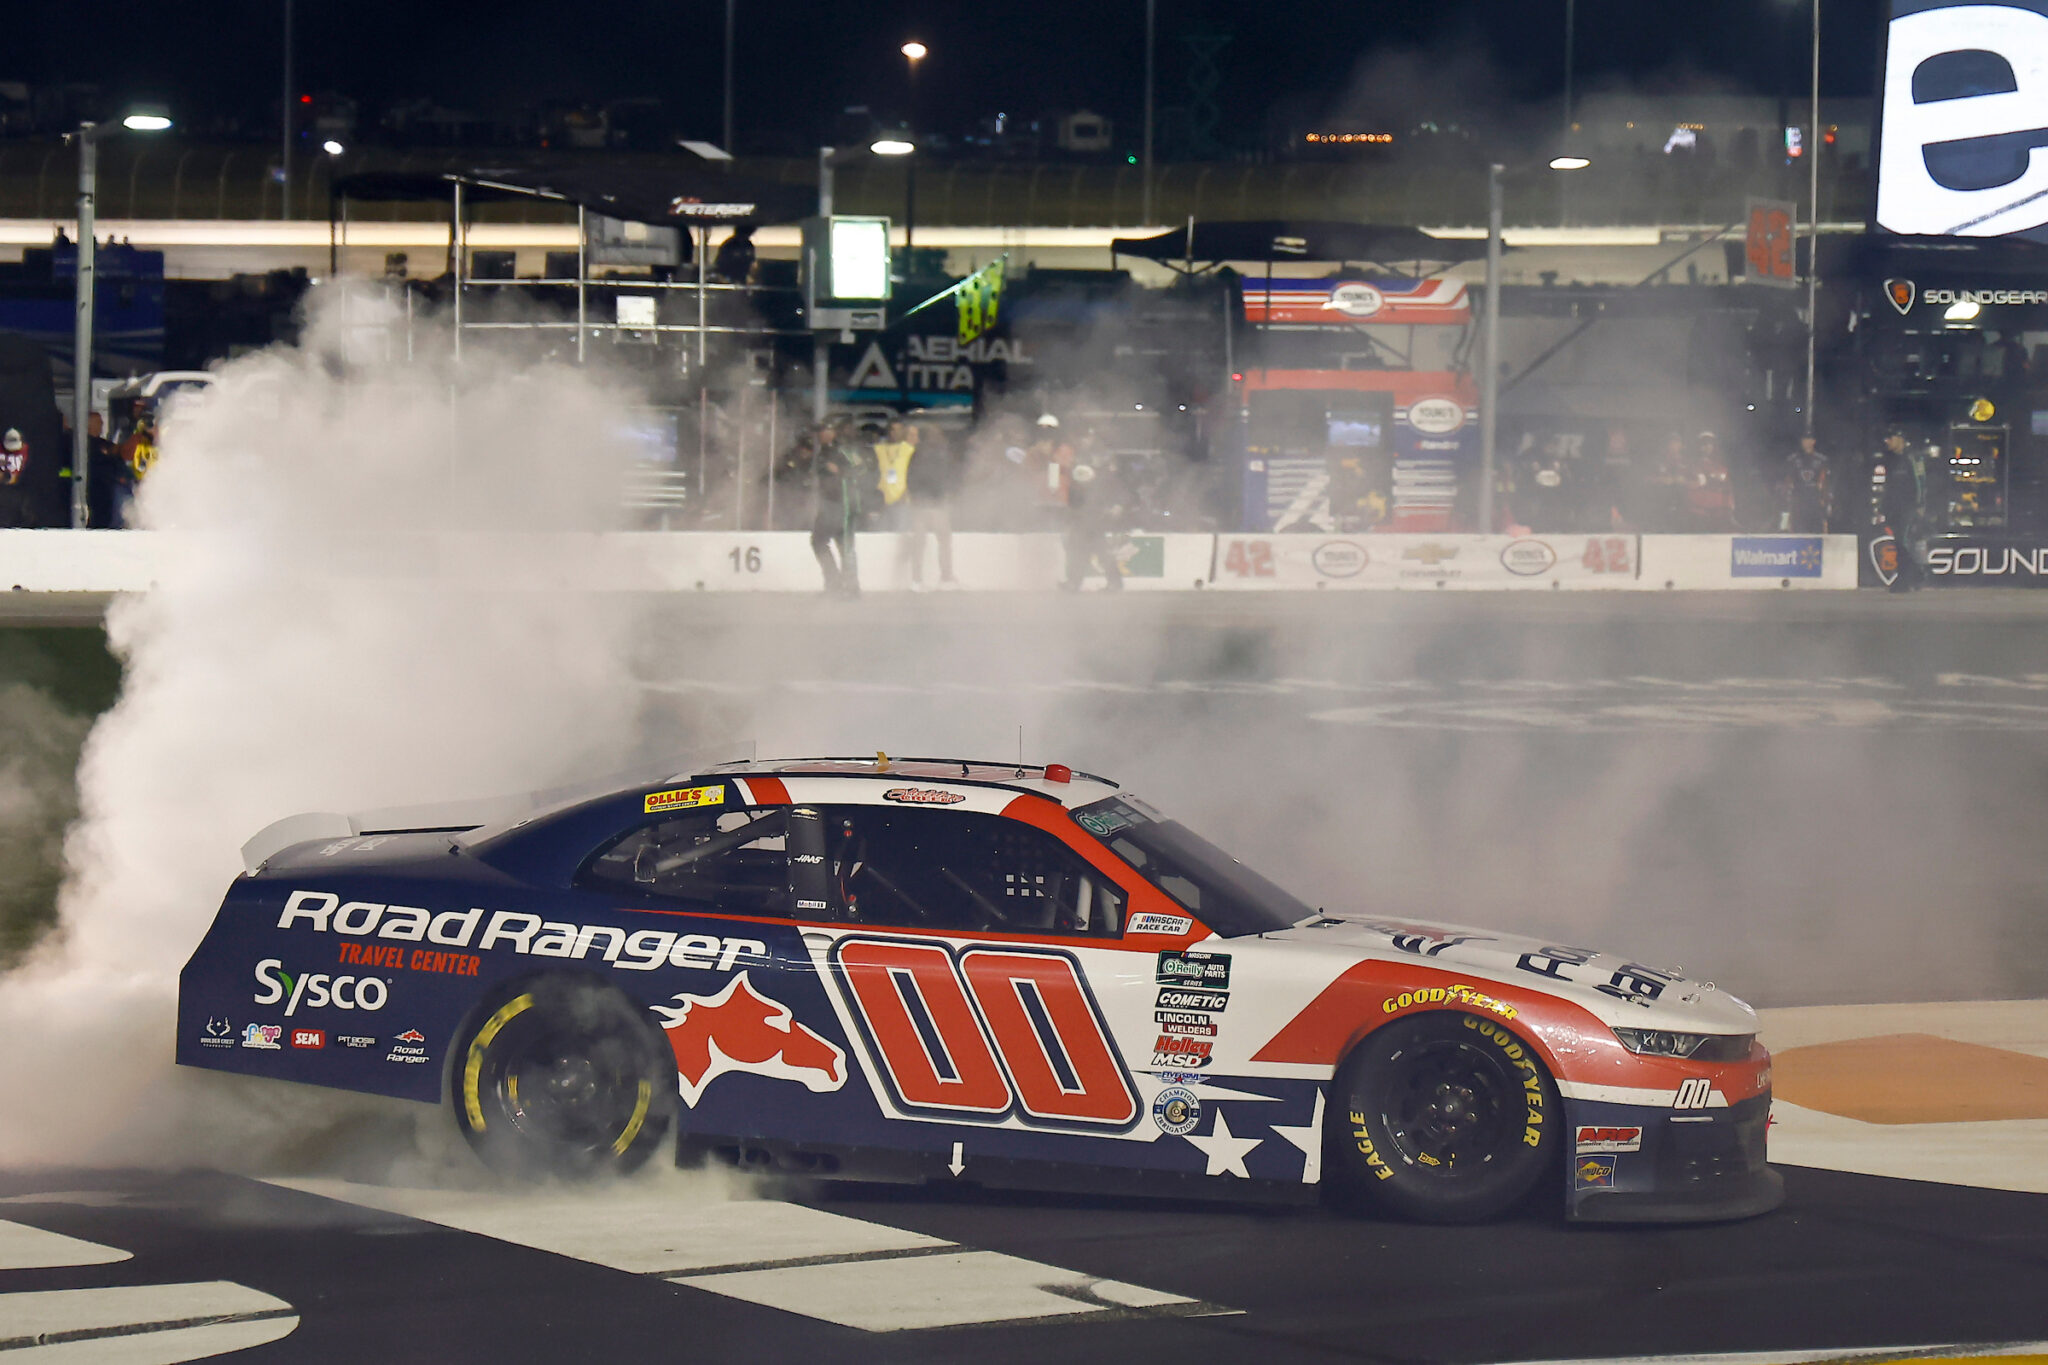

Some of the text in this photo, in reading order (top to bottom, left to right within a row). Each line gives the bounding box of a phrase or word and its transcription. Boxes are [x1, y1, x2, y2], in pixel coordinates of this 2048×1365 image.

[1747, 207, 1792, 277] 42
[1923, 289, 2048, 304] SOUNDGEAR
[728, 546, 761, 573] 16
[1225, 540, 1276, 577] 42
[1582, 538, 1630, 574] 42
[1735, 550, 1797, 565] Walmart
[647, 789, 702, 805] OLLIE'S
[794, 854, 824, 864] HAAS
[1136, 923, 1160, 931] RACE
[1148, 915, 1184, 926] NASCAR
[277, 890, 766, 971] Road Ranger
[339, 942, 480, 977] TRAVEL CENTER
[1187, 952, 1212, 960] NASCAR
[1204, 970, 1226, 979] PARTS
[1206, 963, 1225, 972] AUTO
[1160, 993, 1226, 1009] COMETIC
[1382, 984, 1519, 1021] GOODYEAR
[1157, 1012, 1207, 1025] LINCOLN
[828, 935, 1143, 1134] 00
[1168, 1024, 1212, 1035] WELDERS
[295, 1032, 320, 1046] SEM
[338, 1035, 351, 1043] PIT
[1155, 1035, 1213, 1058] Holley
[393, 1046, 425, 1055] Road
[386, 1053, 430, 1064] Ranger
[1151, 1053, 1203, 1068] MSD
[1463, 1016, 1544, 1148] GOODYEAR
[1160, 1089, 1197, 1106] CHAMPION
[1673, 1078, 1711, 1110] 00
[1157, 1115, 1197, 1134] IRRIGATION
[1578, 1128, 1640, 1142] ARP
[1350, 1111, 1395, 1181] EAGLE
